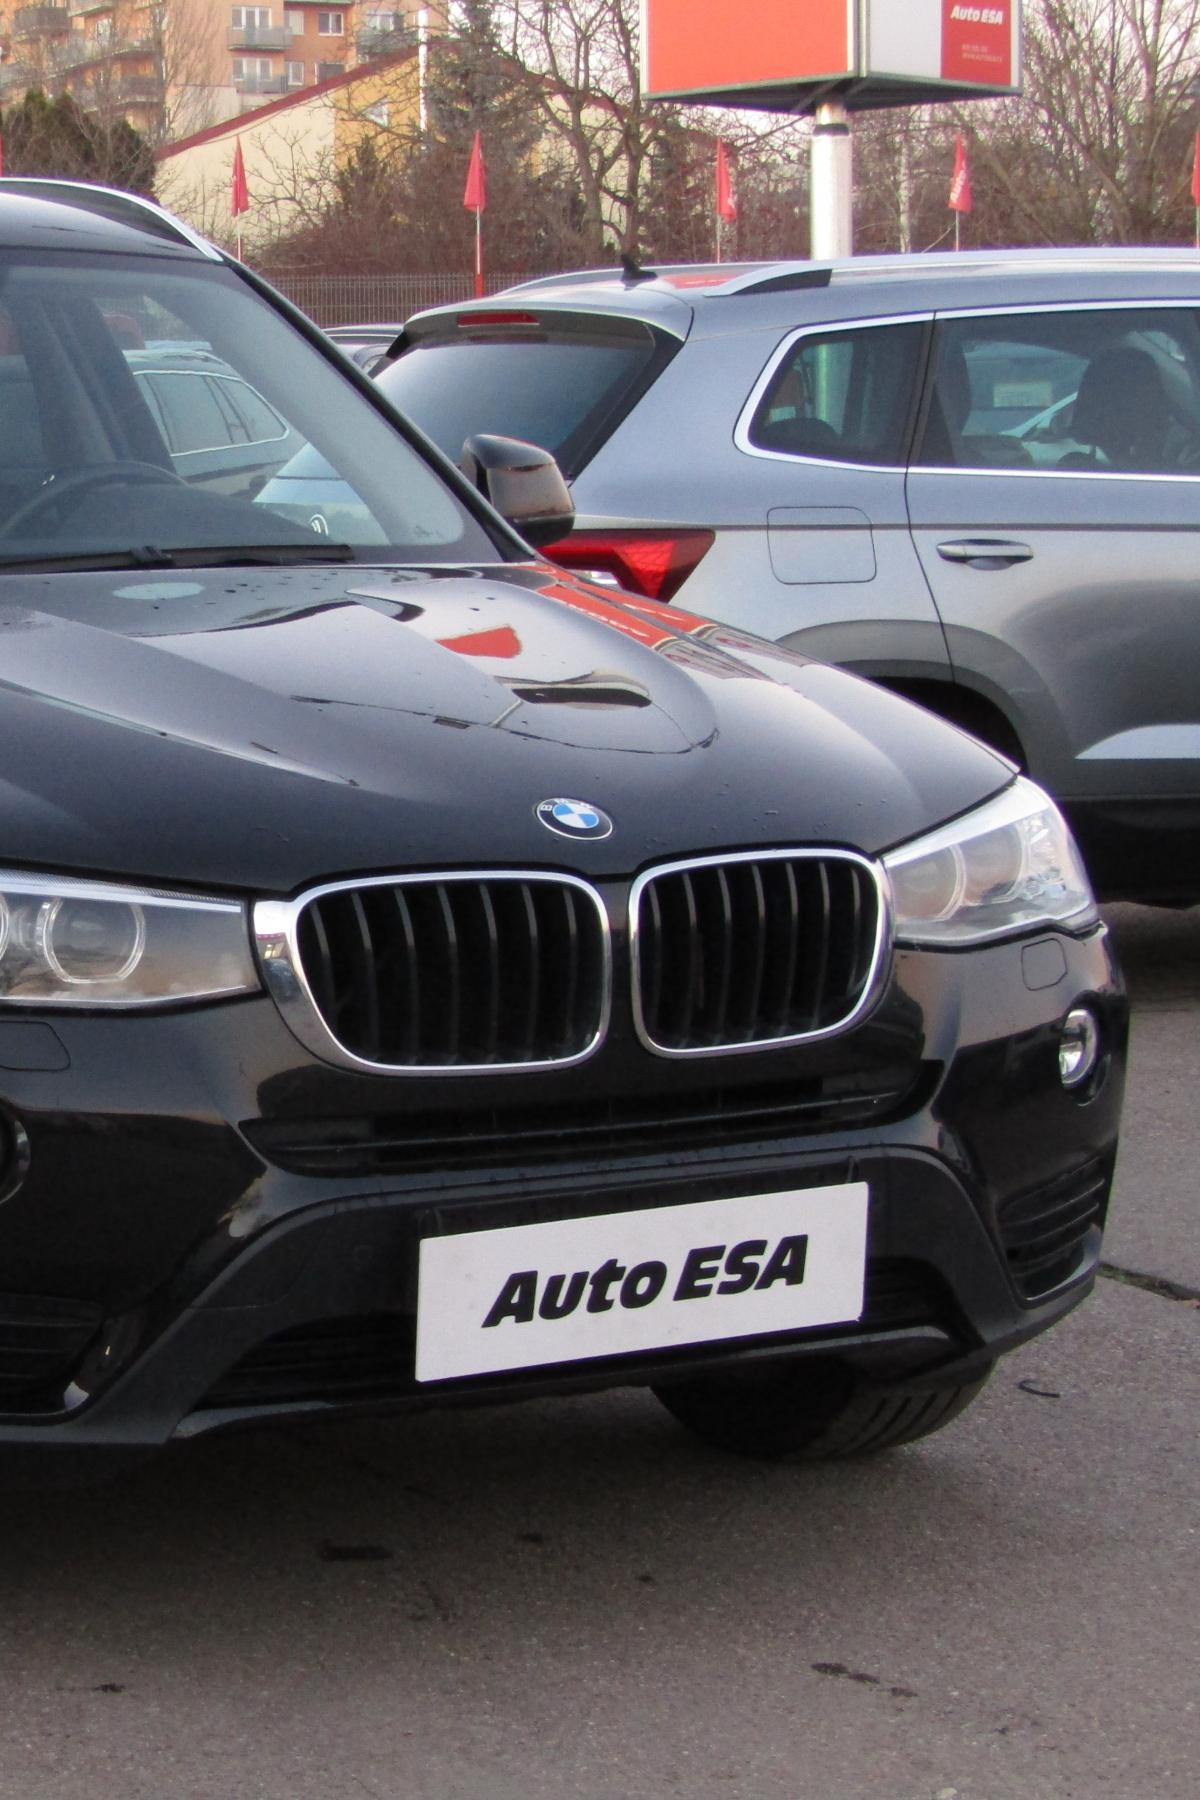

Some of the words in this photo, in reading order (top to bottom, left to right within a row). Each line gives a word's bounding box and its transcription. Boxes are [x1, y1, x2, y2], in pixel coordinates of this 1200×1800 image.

[950, 5, 981, 22] Auto
[981, 8, 1004, 25] ESA
[481, 1258, 667, 1328] Auto
[673, 1234, 808, 1301] ESA
